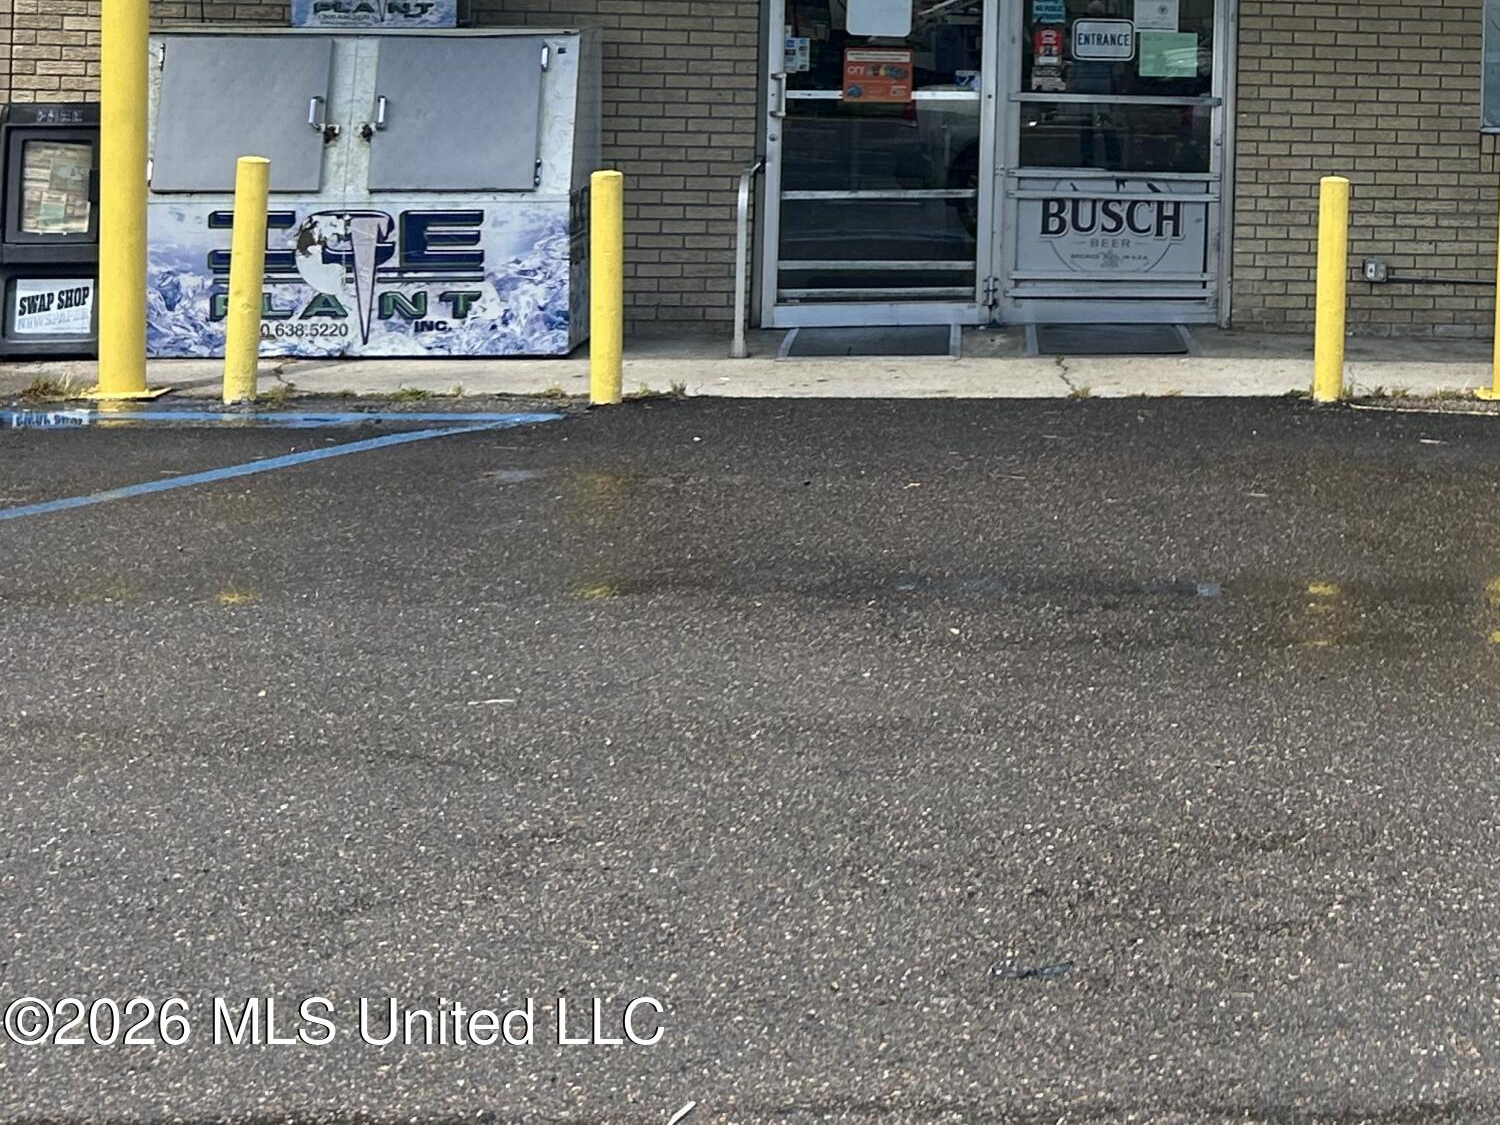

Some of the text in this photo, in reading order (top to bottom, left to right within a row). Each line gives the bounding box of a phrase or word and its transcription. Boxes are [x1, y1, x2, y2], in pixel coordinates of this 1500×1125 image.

[313, 2, 435, 15] PLANT
[1077, 33, 1131, 47] ENTRANCE
[1040, 198, 1184, 239] BUSCH
[1090, 239, 1131, 248] BEER
[18, 286, 90, 317] SWAP SHOP
[414, 320, 453, 332] INC.
